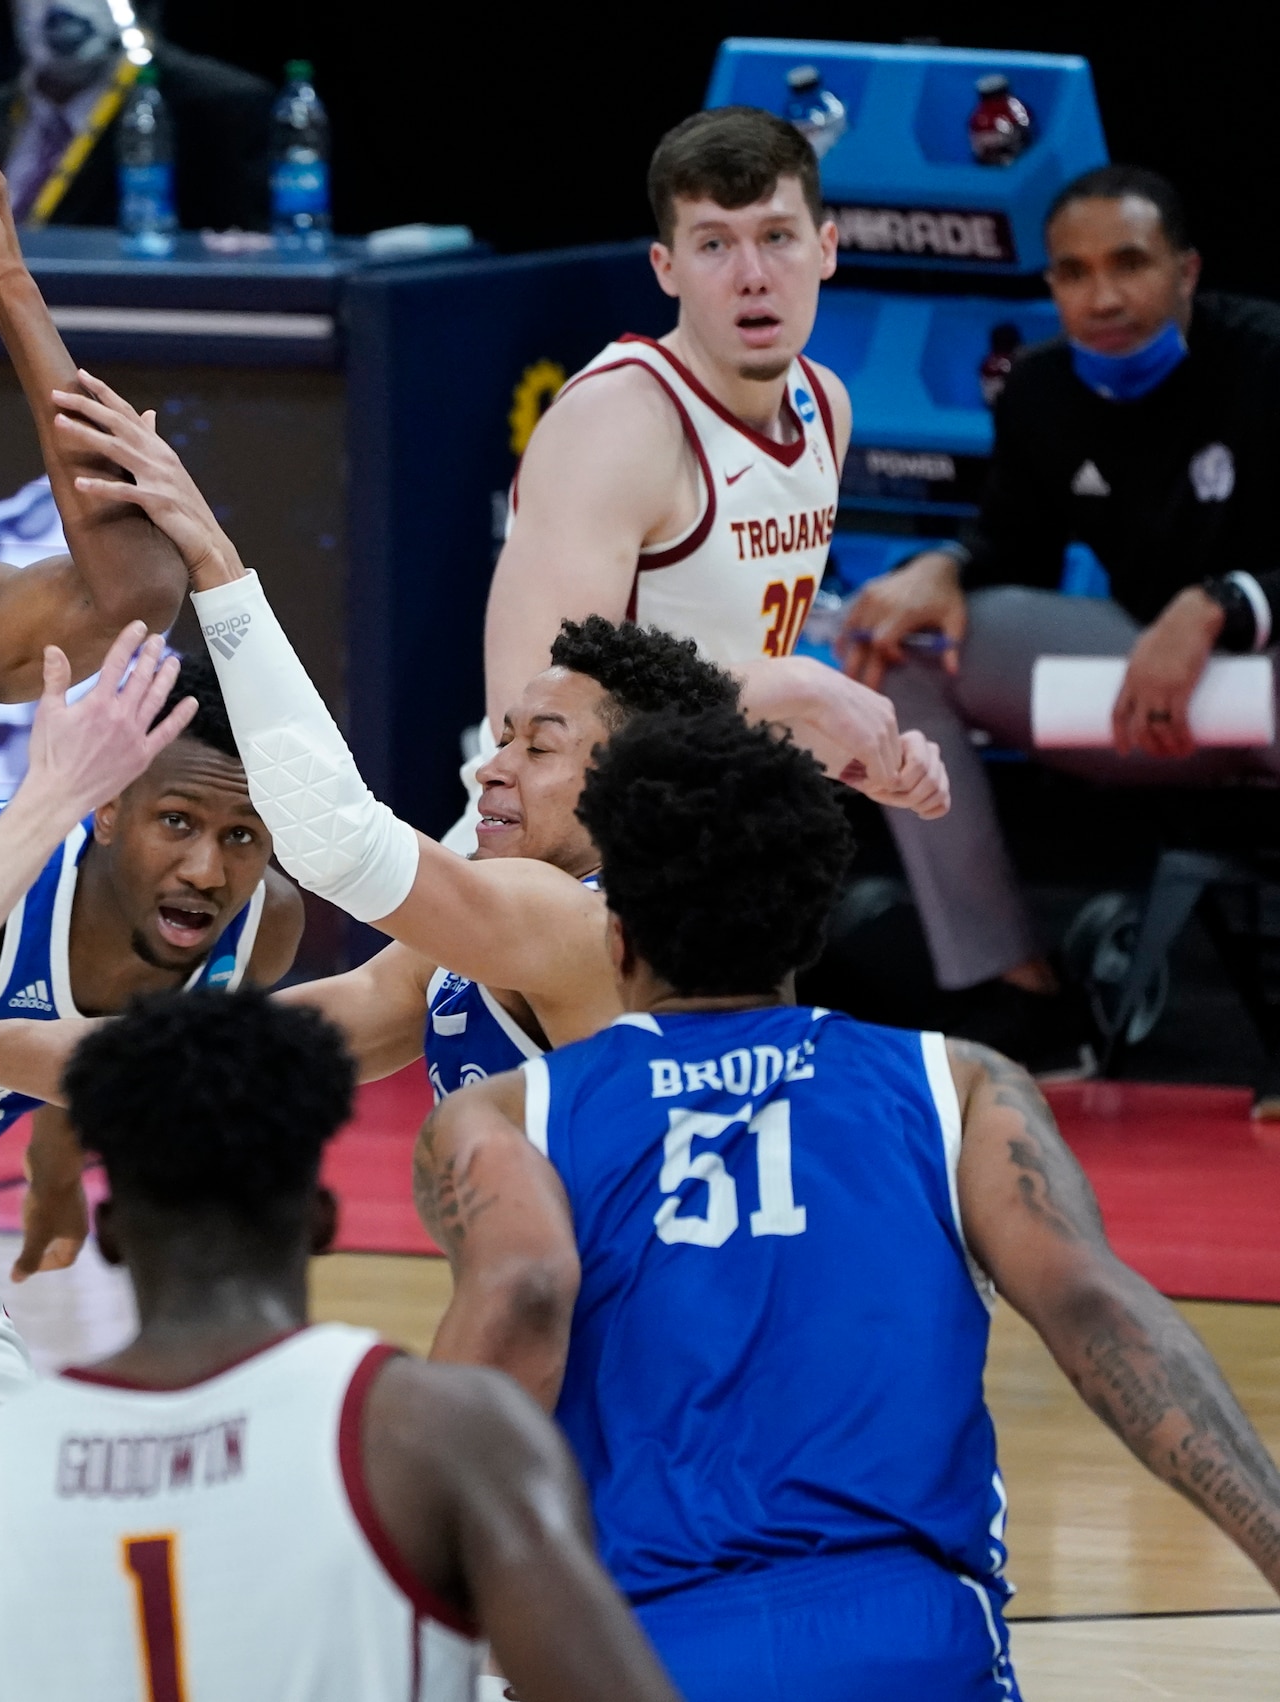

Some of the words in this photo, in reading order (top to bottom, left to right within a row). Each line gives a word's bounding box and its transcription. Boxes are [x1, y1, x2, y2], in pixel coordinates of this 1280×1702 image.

[730, 504, 835, 561] TROJANS
[761, 574, 816, 658] 30
[8, 997, 53, 1012] adidas
[653, 1097, 808, 1249] 51
[56, 1413, 249, 1499] GOODWIN
[121, 1530, 190, 1702] 1
